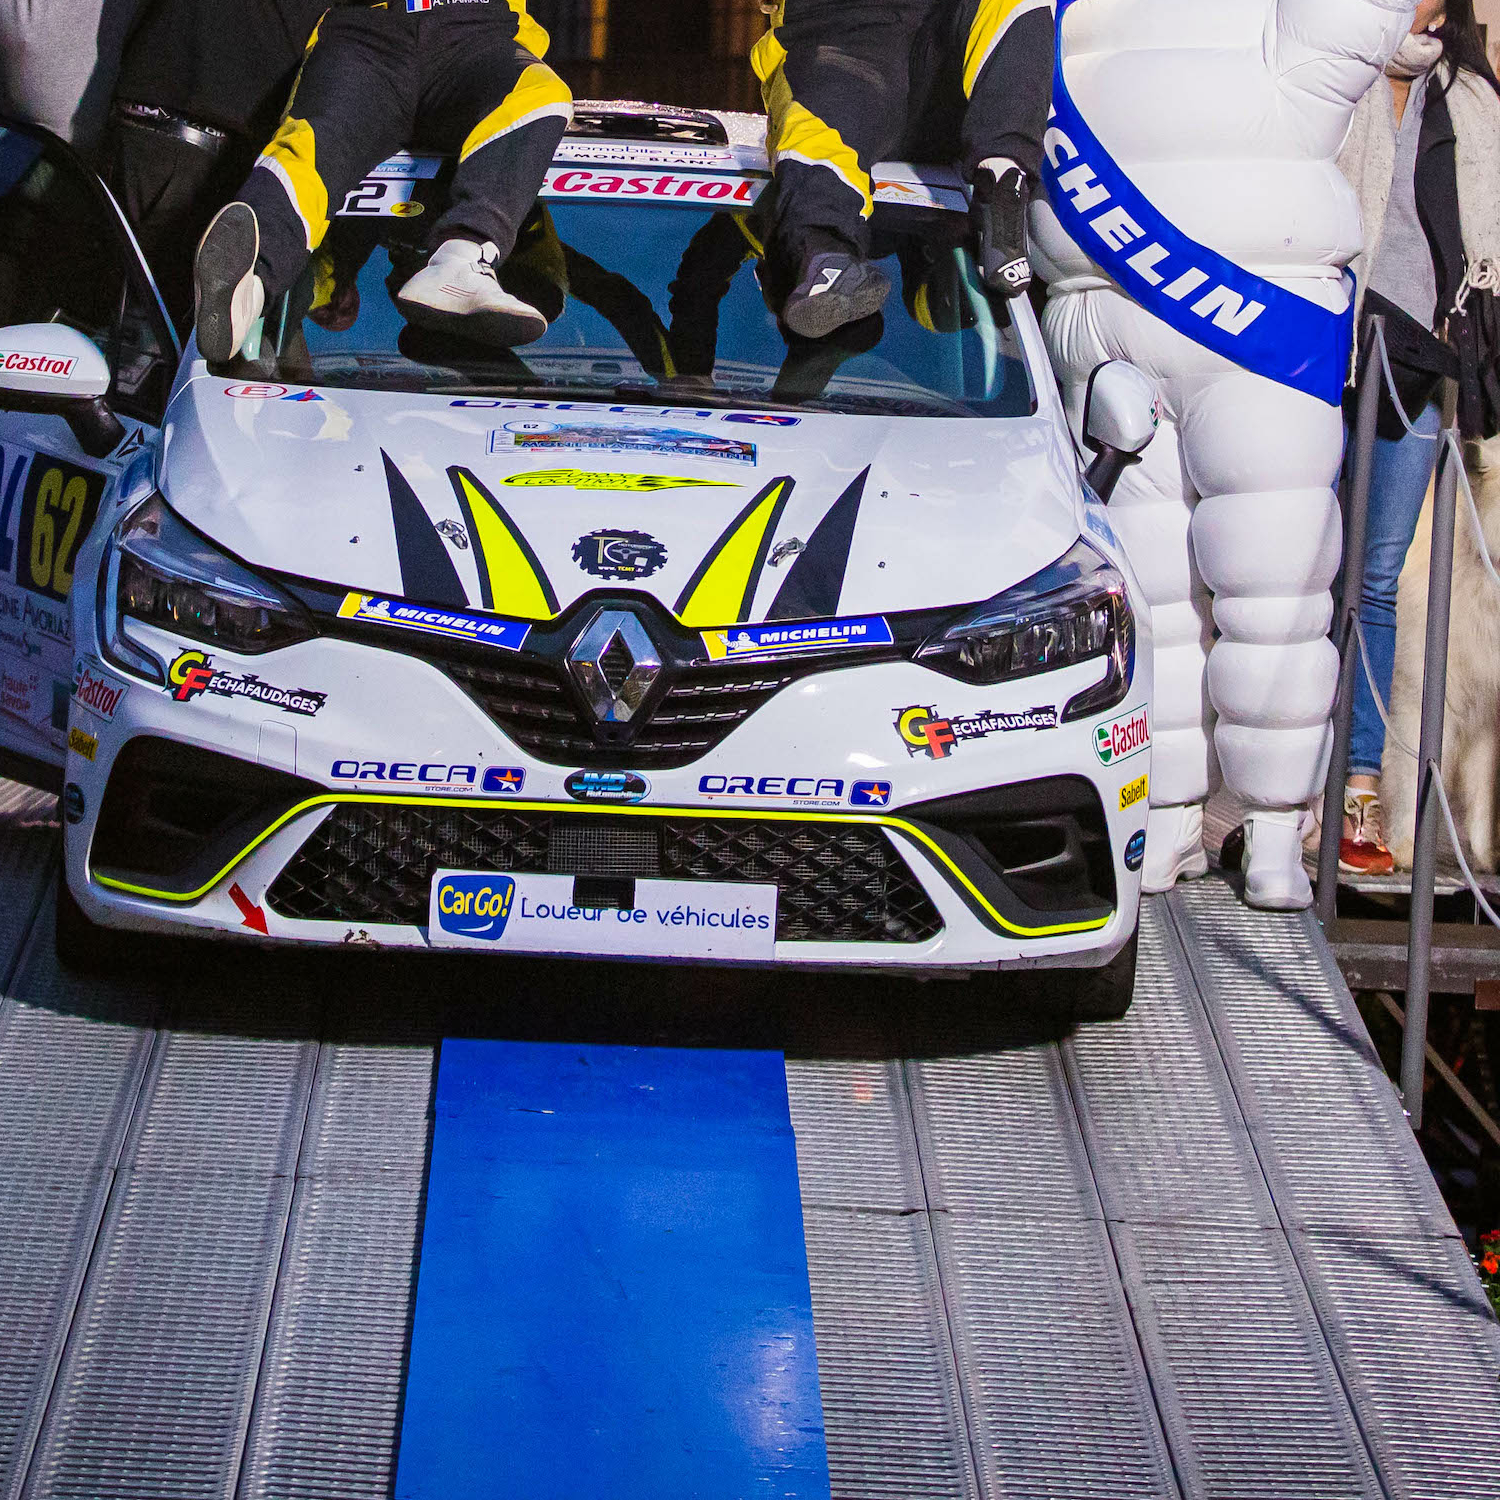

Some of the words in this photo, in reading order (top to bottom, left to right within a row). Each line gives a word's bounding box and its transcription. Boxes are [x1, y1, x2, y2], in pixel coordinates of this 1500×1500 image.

[552, 171, 754, 201] Castrol
[1043, 115, 1267, 337] CHELIN
[5, 352, 75, 377] Castrol
[449, 399, 713, 418] ORECA
[30, 466, 88, 596] 62
[394, 606, 506, 638] MICHELIN
[759, 623, 867, 644] MICHELIN
[78, 668, 124, 717] Castrol
[168, 650, 212, 701] GF
[208, 674, 319, 715] ECHAFAUDAGES
[897, 708, 953, 759] GF
[951, 710, 1057, 737] ECHAFAUDAGES
[1111, 710, 1150, 757] Castrol
[331, 759, 477, 784] ORECA
[698, 774, 844, 797] ORECA
[425, 785, 474, 793] STORE.COM
[1121, 776, 1146, 809] Sabelt
[520, 896, 608, 923] Loueur
[657, 904, 770, 931] véhicules
